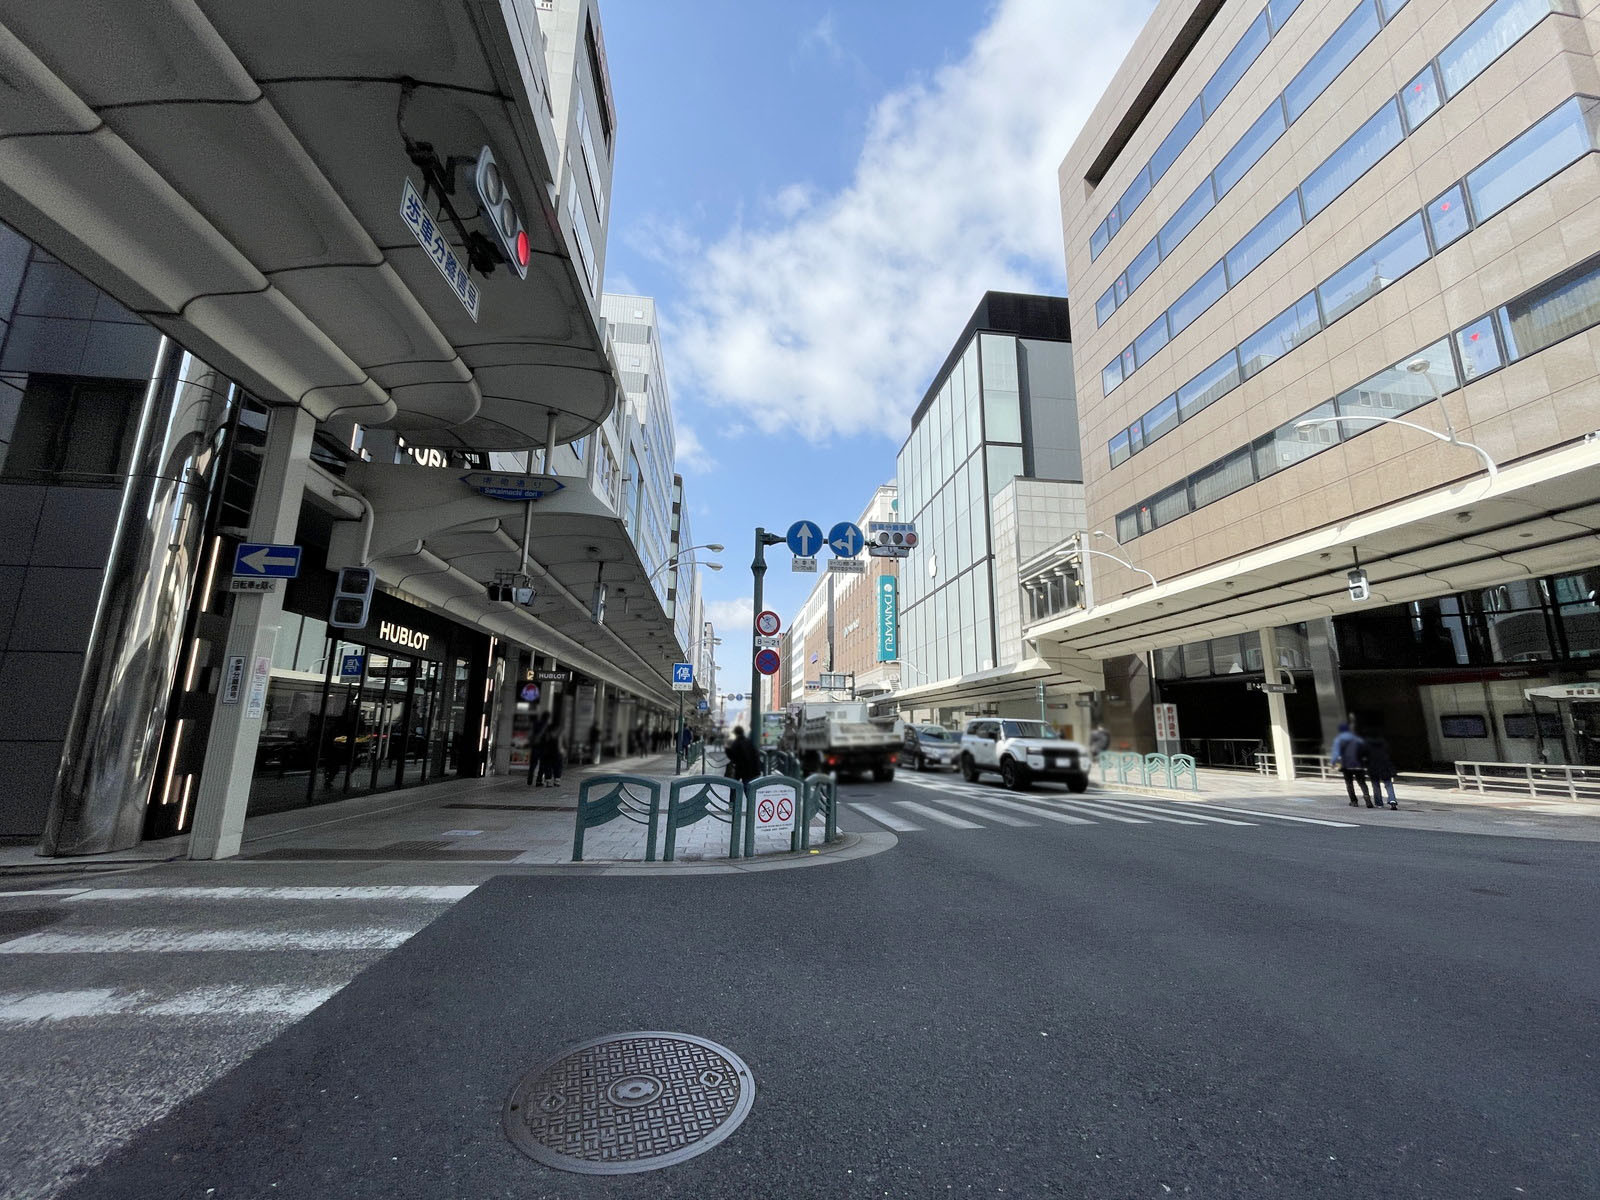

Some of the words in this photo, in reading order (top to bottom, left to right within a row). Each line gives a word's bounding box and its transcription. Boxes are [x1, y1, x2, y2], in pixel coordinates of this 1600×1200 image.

[405, 193, 477, 311] 歩車分離信号
[379, 620, 430, 651] HUBLOT
[676, 666, 691, 681] 停
